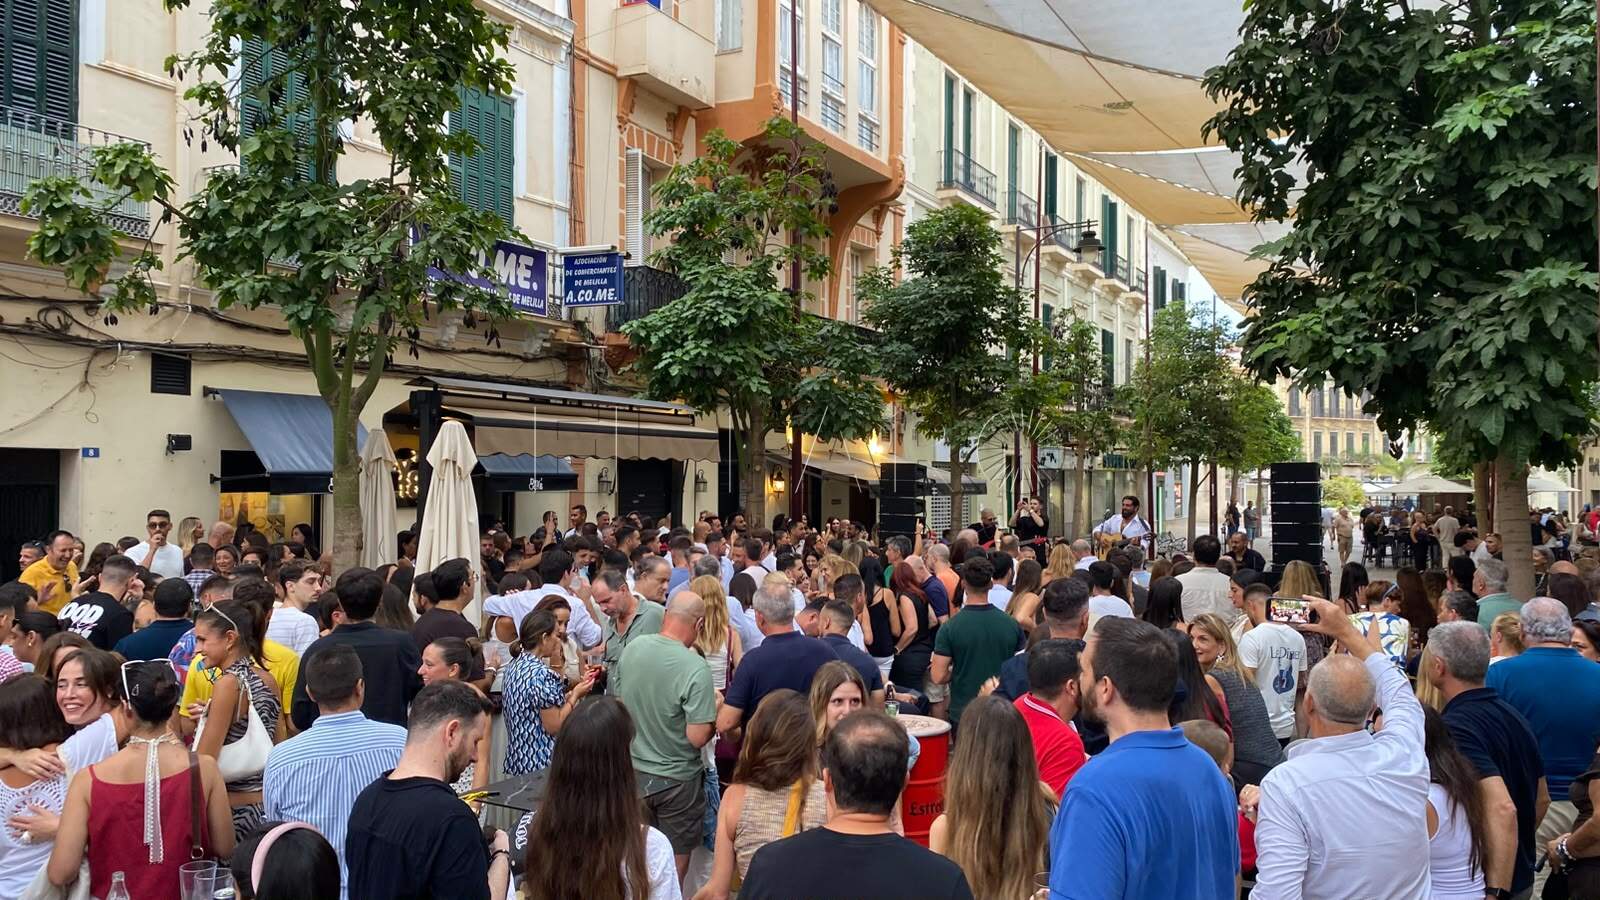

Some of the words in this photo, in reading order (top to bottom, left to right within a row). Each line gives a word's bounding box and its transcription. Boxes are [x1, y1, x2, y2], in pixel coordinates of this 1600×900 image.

[574, 266, 617, 275] COMERCIANTES
[583, 278, 607, 286] MELILLA
[512, 292, 520, 304] DE
[521, 295, 544, 309] MELILLA
[566, 288, 617, 303] A.CO.ME.
